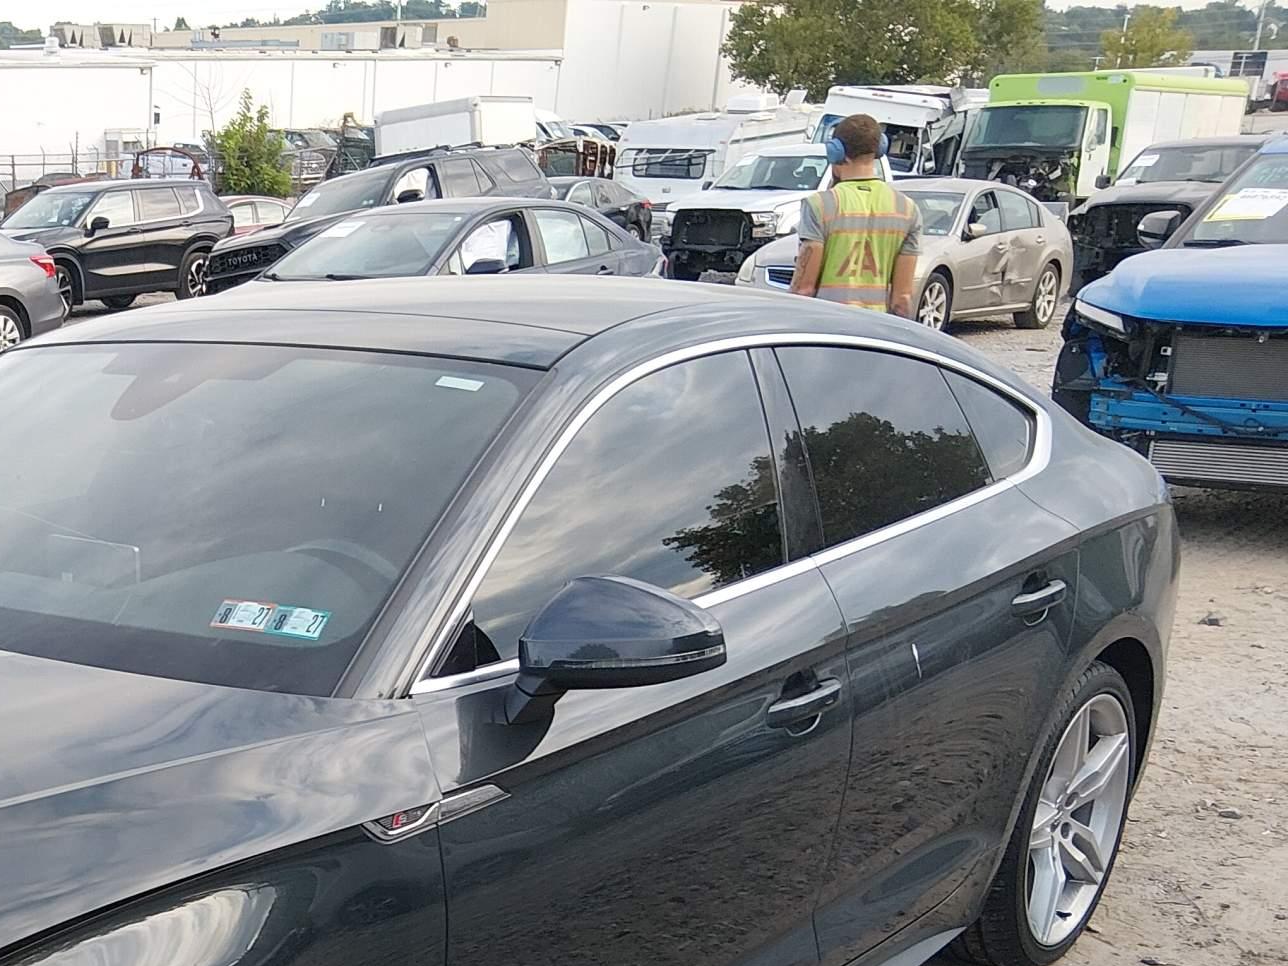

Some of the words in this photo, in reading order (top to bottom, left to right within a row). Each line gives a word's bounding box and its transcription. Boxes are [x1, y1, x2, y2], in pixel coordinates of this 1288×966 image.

[228, 253, 258, 265] TOYOTA
[219, 607, 232, 624] 8
[252, 607, 271, 627] 27
[274, 614, 287, 631] 8
[306, 614, 325, 634] 27
